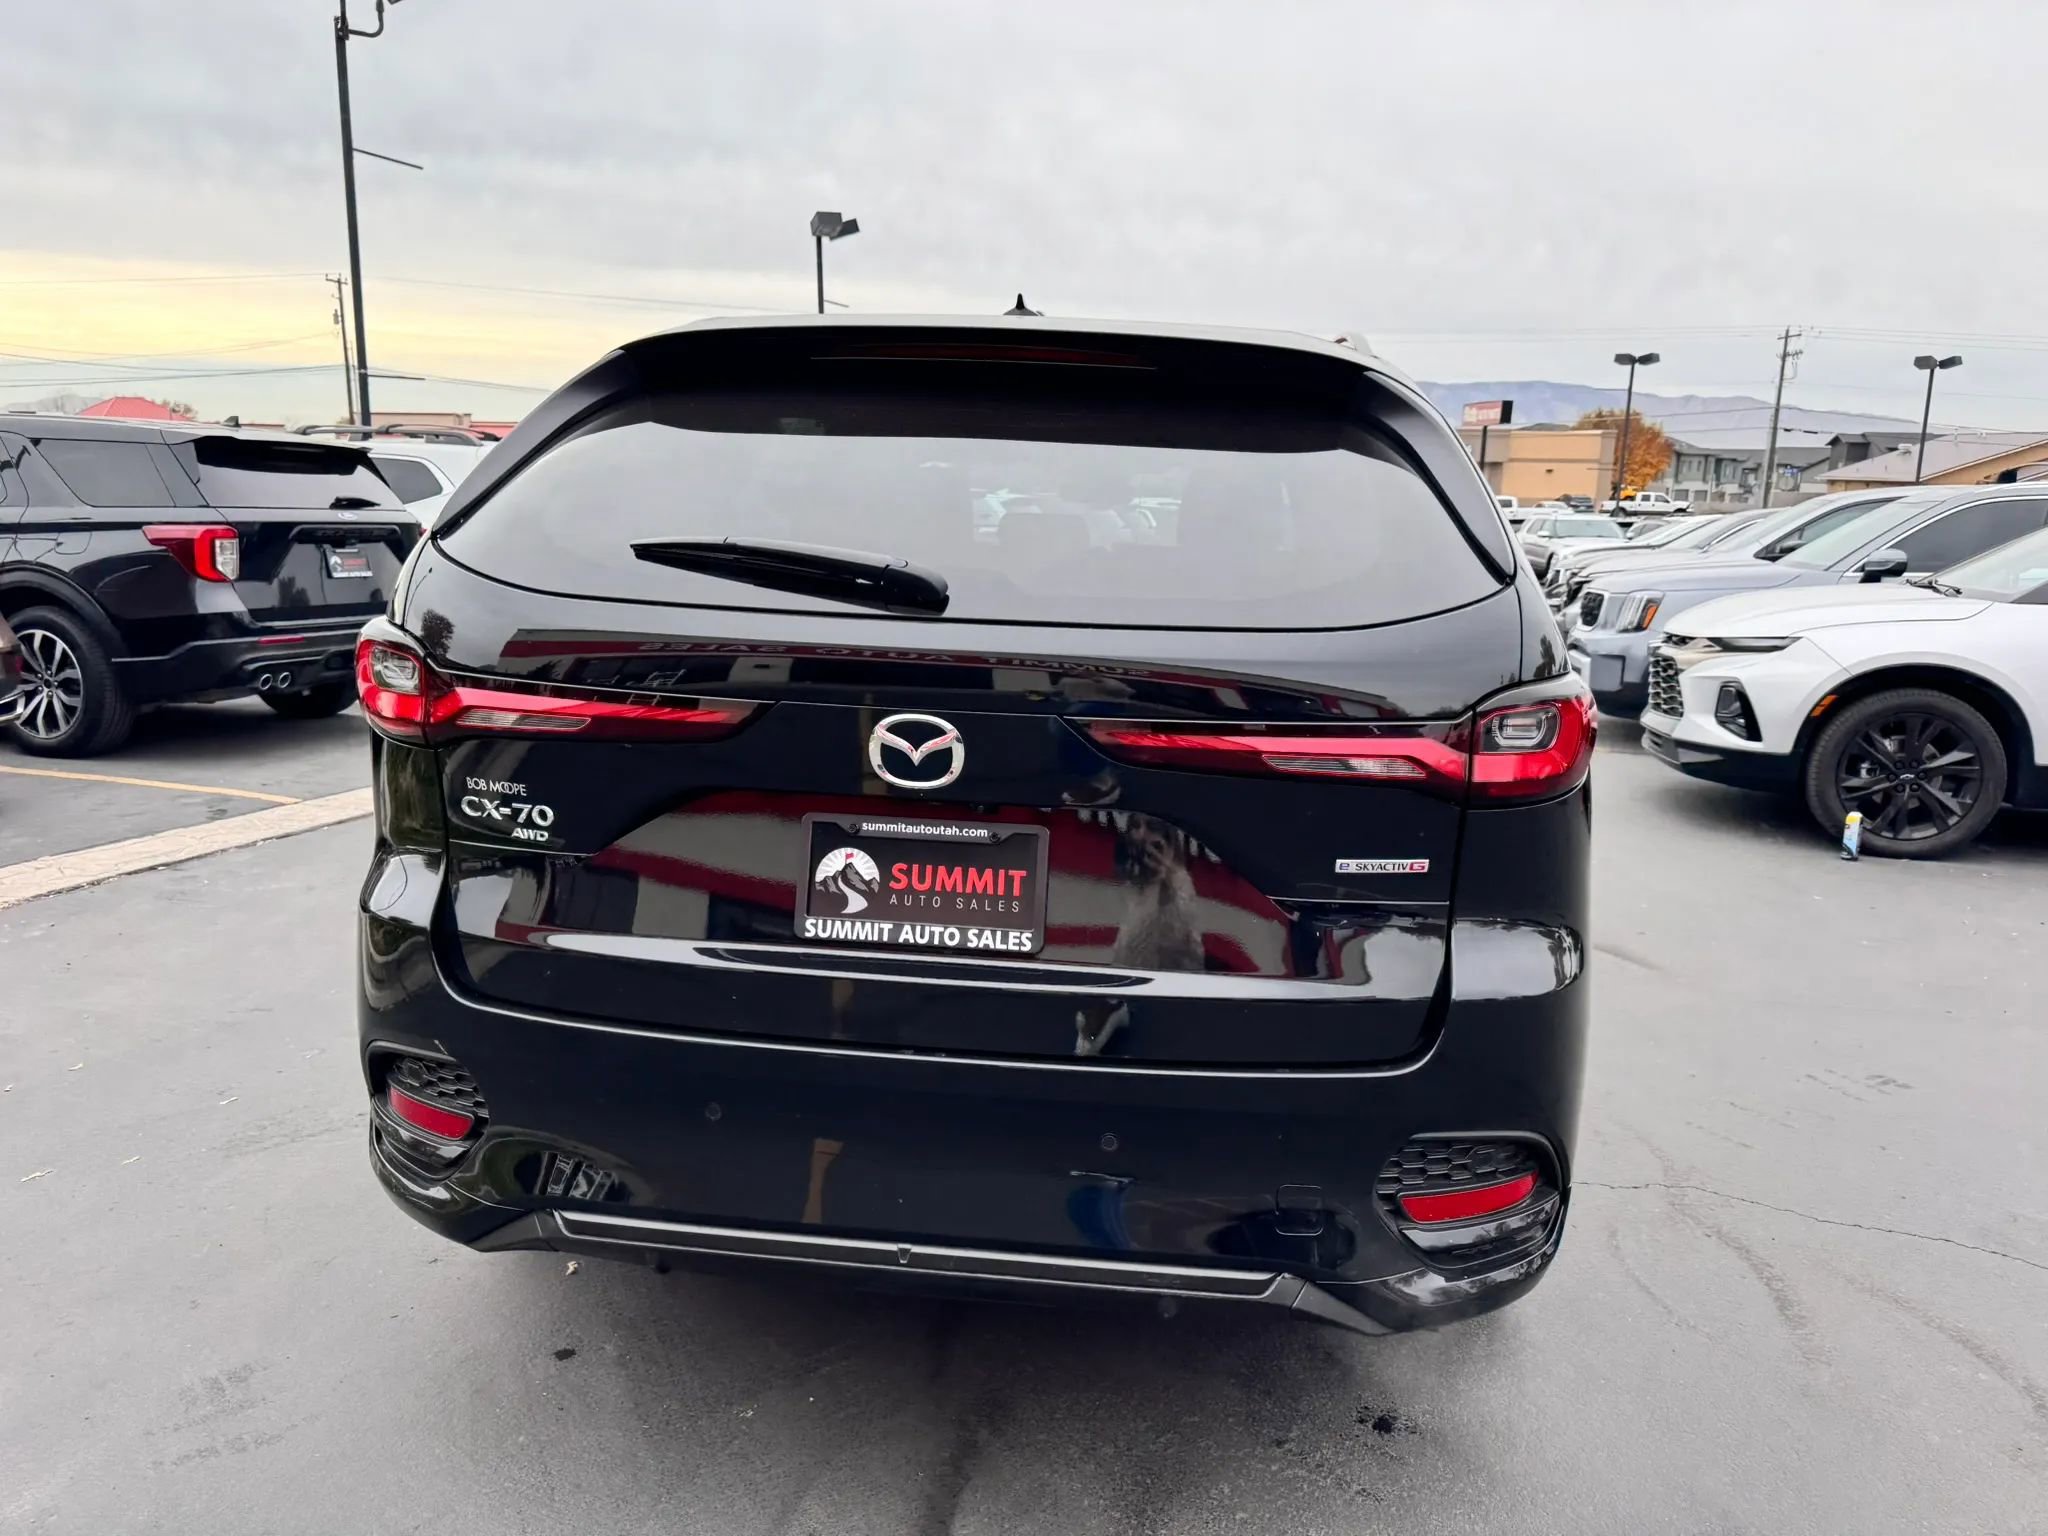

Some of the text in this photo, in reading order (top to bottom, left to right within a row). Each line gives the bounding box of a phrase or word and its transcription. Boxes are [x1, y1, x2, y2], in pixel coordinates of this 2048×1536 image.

[466, 776, 487, 791] BOB
[460, 795, 555, 827] CX-70
[511, 827, 549, 842] AWD
[861, 820, 988, 838] summitautoutah.com
[889, 862, 1027, 897] SUMMIT
[889, 894, 1020, 913] AUTO SALES
[804, 918, 1033, 951] SUMMIT AUTO SALES
